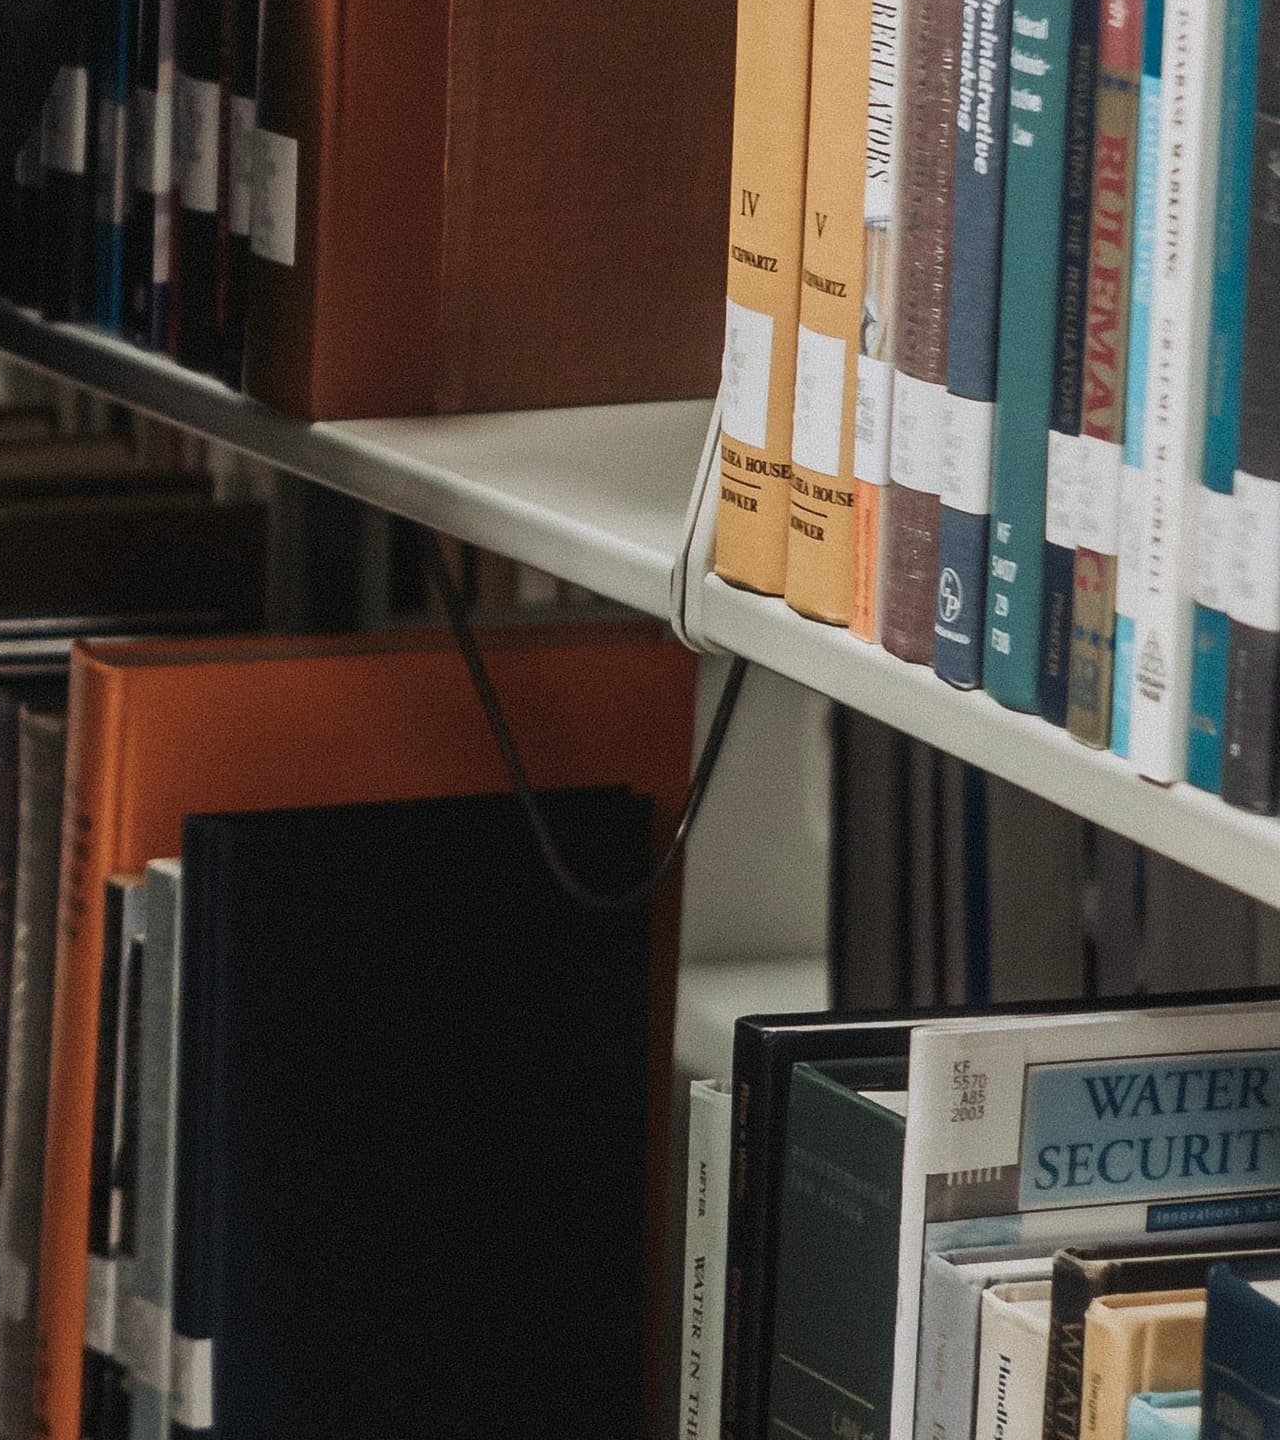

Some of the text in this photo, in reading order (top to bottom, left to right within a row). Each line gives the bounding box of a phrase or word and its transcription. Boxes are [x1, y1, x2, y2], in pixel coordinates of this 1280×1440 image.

[866, 2, 898, 184] REGULATORS
[1172, 8, 1192, 127] DATABASE
[1069, 43, 1088, 199] REGULATING
[740, 188, 760, 219] IV
[814, 211, 828, 239] V
[1164, 142, 1184, 281] MARKETING
[1066, 209, 1081, 255] THE
[1075, 133, 1131, 592] RULEMAG
[744, 454, 791, 480] HOUSE
[812, 481, 855, 508] HOUSE
[952, 1073, 988, 1091] 5570
[953, 1060, 971, 1074] KF
[1082, 1065, 1272, 1121] WATER
[950, 1104, 985, 1123] 2003
[1033, 1126, 1280, 1191] SECURIT
[697, 1160, 707, 1219] MEYER
[690, 1255, 707, 1338] WATER
[689, 1347, 702, 1381] IN
[1086, 1371, 1103, 1433] Siegan
